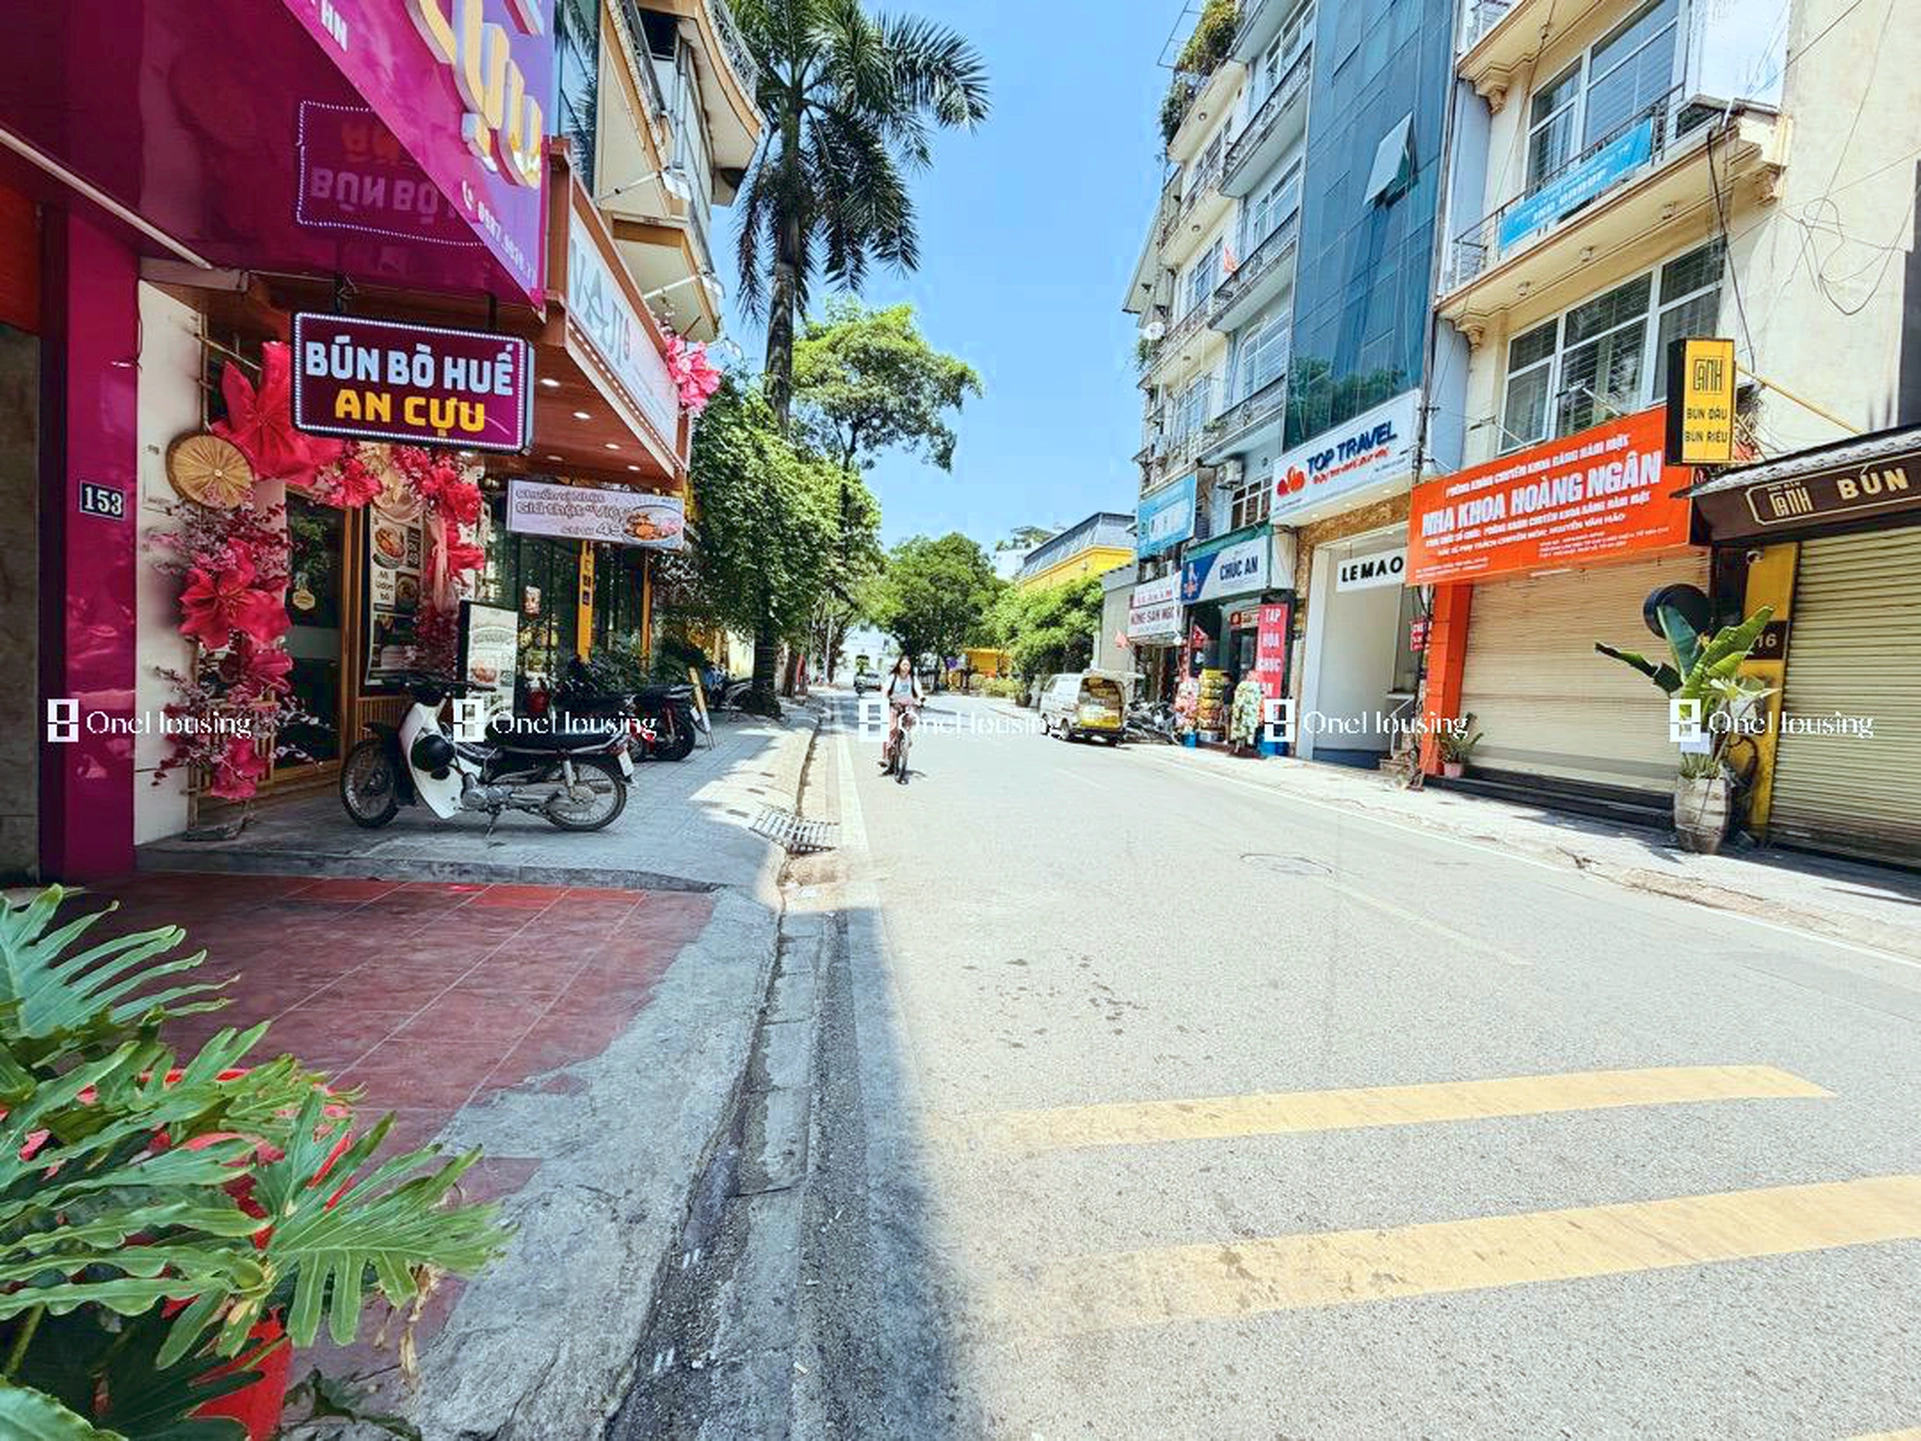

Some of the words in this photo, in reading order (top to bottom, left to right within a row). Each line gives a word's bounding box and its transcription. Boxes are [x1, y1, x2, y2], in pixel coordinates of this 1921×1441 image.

[305, 334, 380, 383] BÚN
[387, 342, 435, 389] BÒ
[443, 343, 514, 396] HUẾ
[335, 389, 392, 422] AN
[403, 395, 486, 438] CỰU
[1307, 447, 1335, 475] TOP
[1336, 420, 1398, 463] TRAVEL
[84, 486, 122, 515] 153
[1422, 506, 1455, 538] NHA
[1457, 493, 1506, 529] KHOA
[1510, 471, 1584, 516] HOÀNG
[1585, 450, 1663, 498] NGÂN
[1836, 464, 1909, 500] BÚN
[1341, 556, 1404, 583] LEMAO
